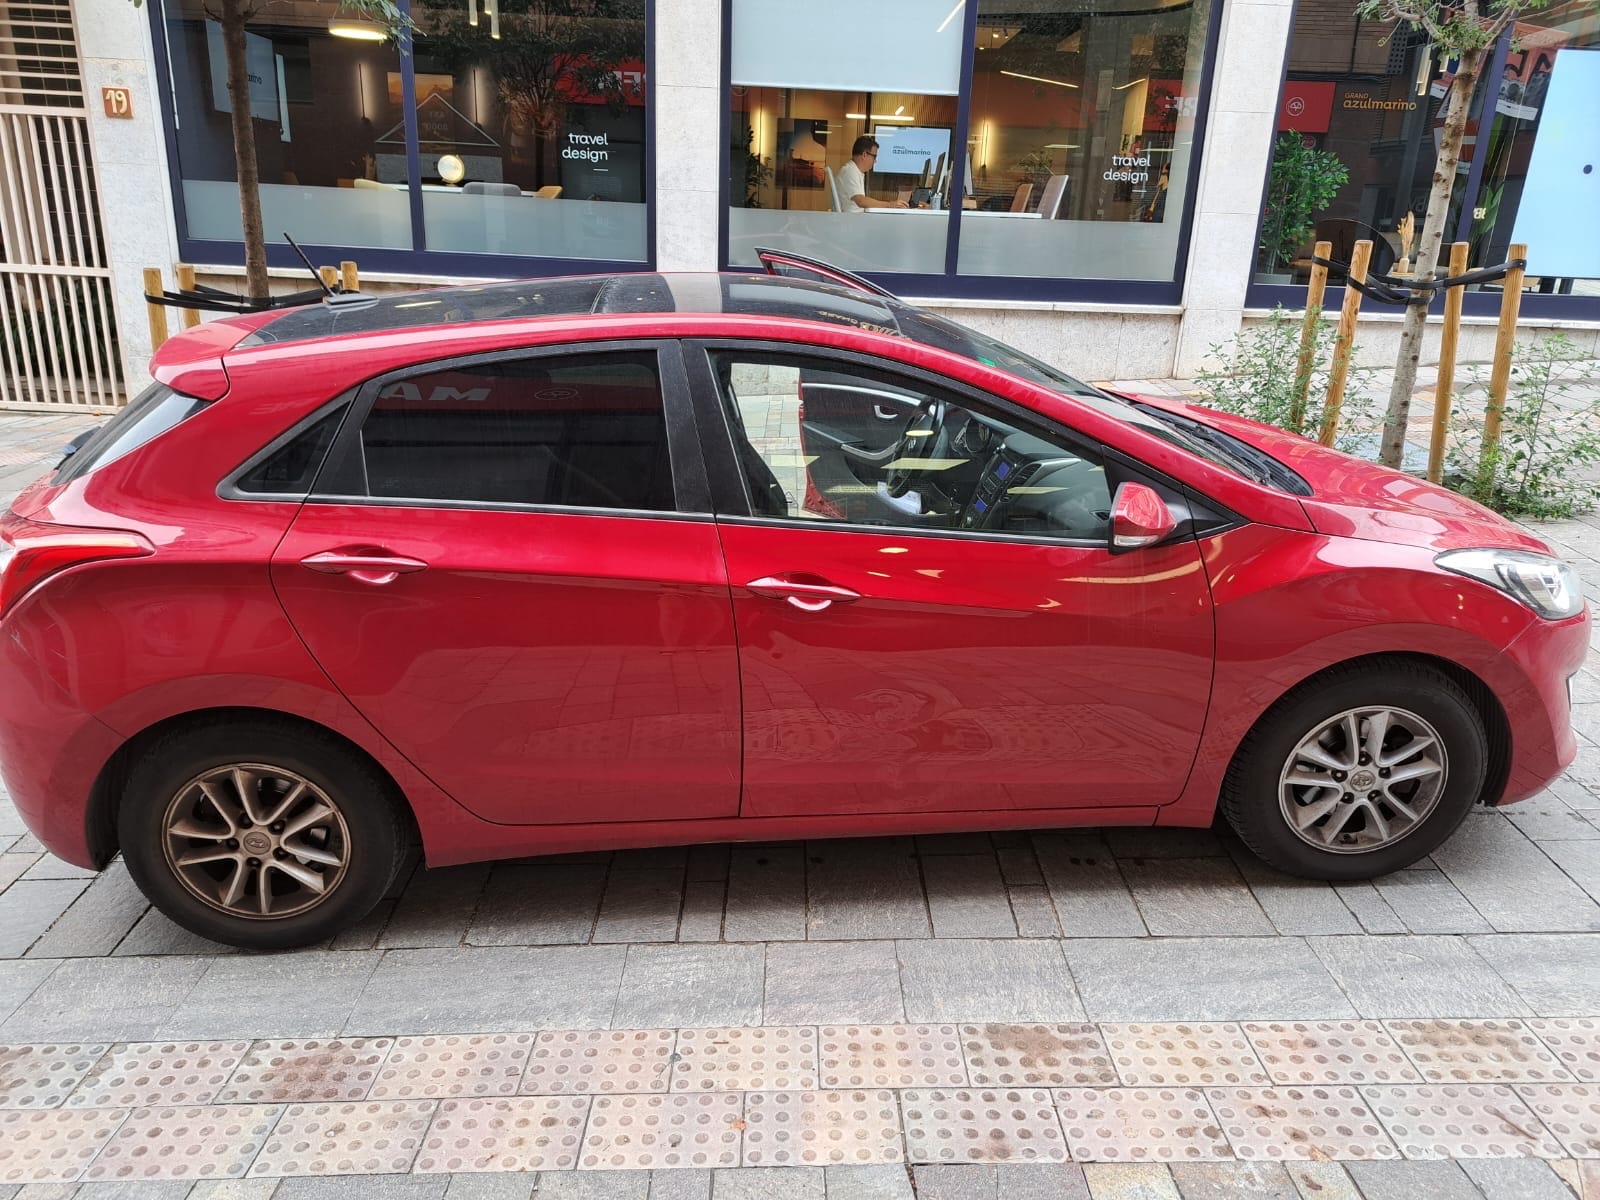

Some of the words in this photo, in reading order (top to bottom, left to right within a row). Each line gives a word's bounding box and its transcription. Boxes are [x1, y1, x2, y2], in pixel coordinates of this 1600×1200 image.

[105, 90, 128, 114] 19
[1343, 98, 1417, 111] azulmarino
[568, 132, 609, 146] travel
[561, 146, 609, 163] design
[1112, 154, 1151, 167] travel
[1103, 168, 1149, 184] design
